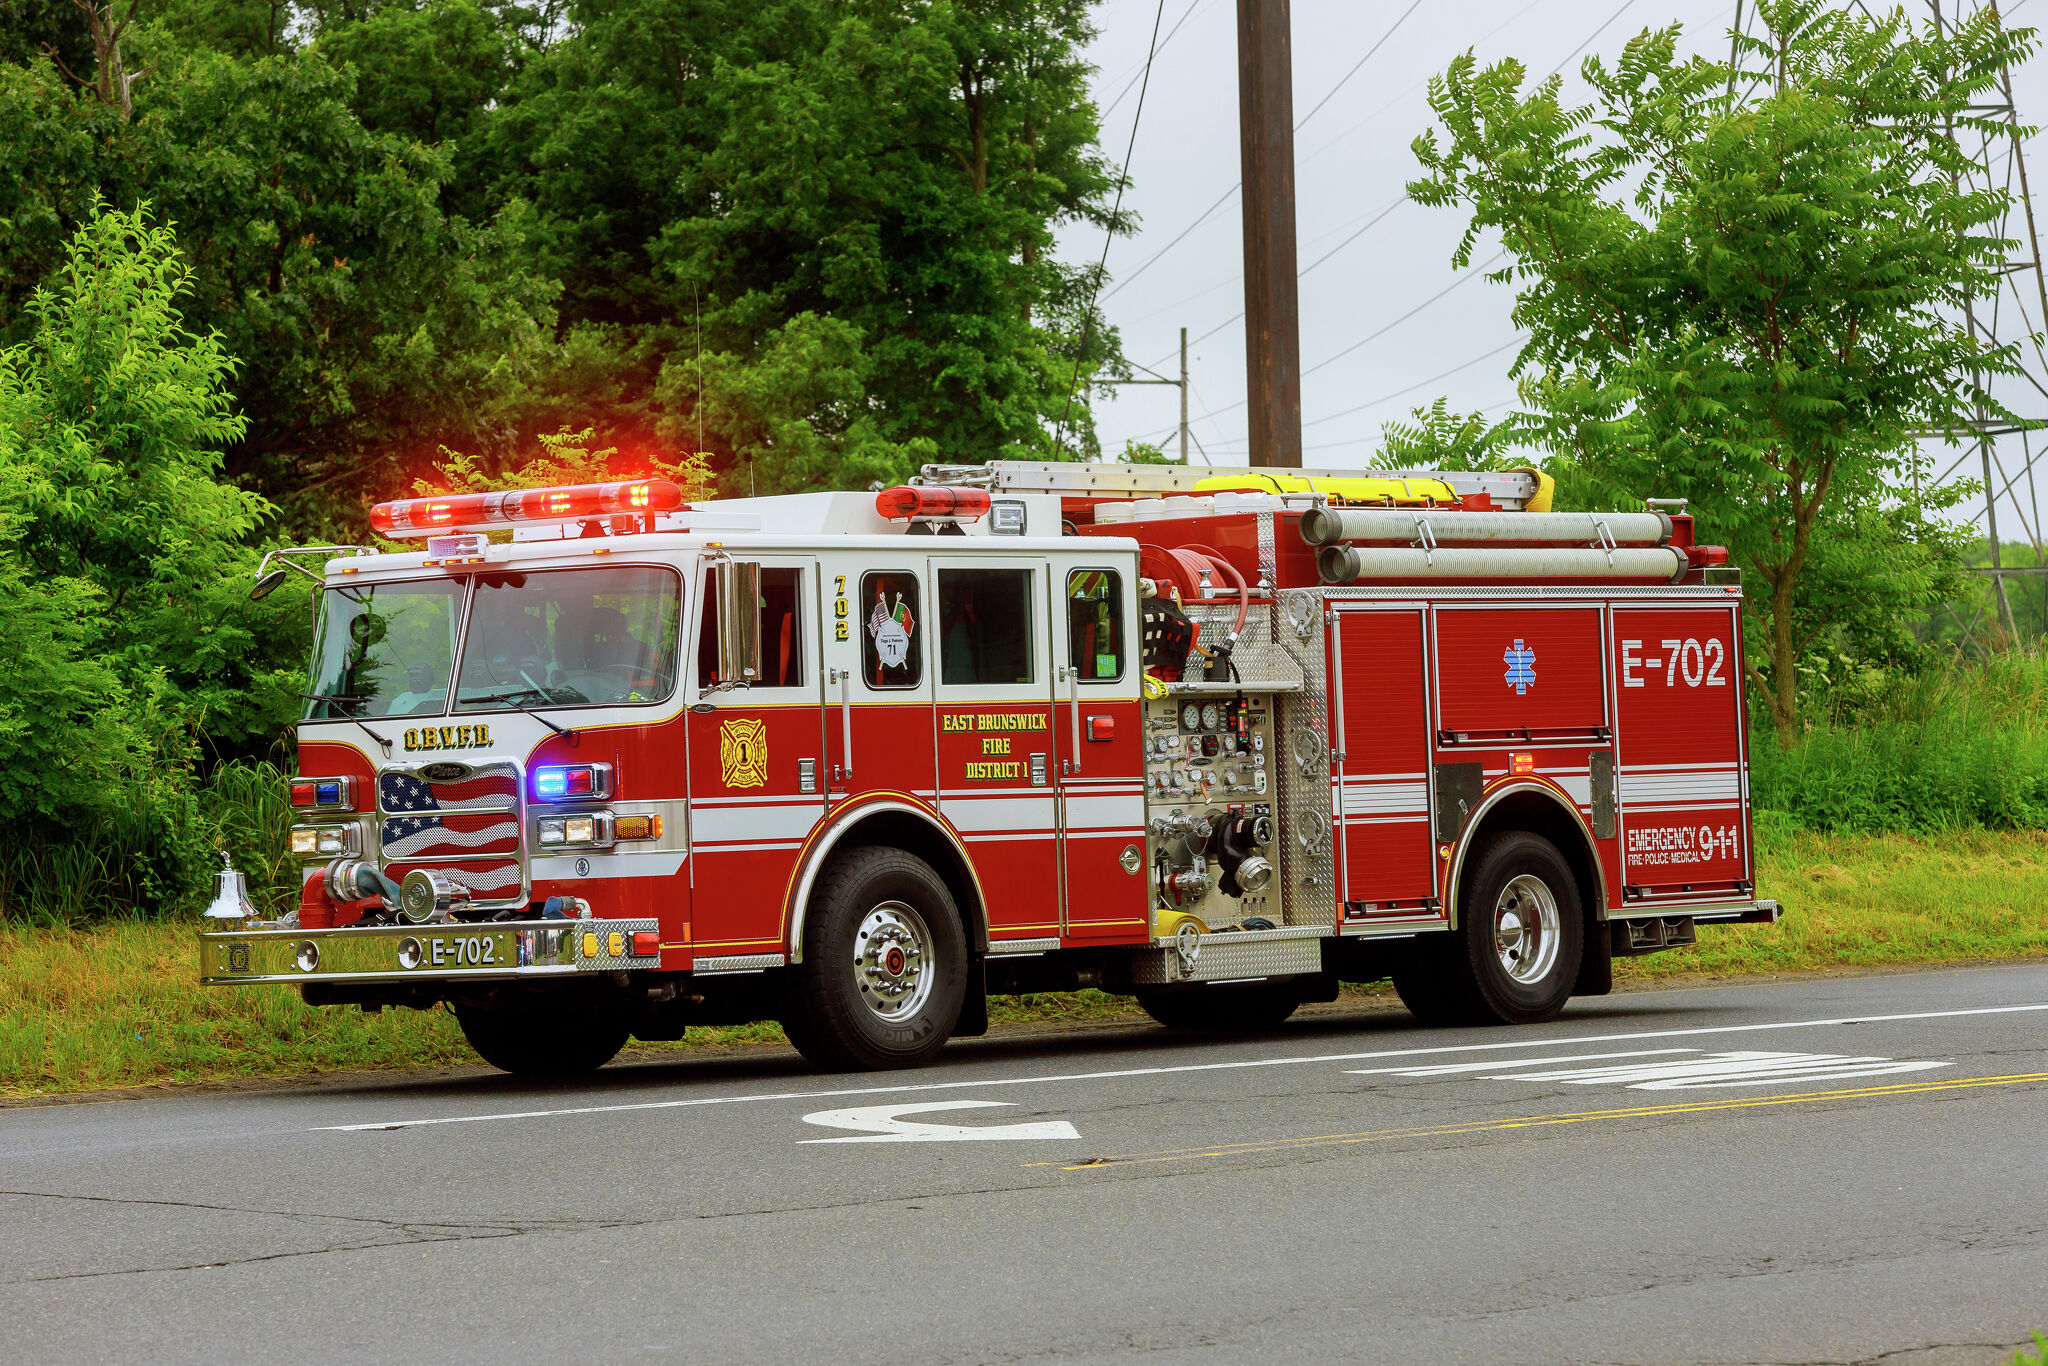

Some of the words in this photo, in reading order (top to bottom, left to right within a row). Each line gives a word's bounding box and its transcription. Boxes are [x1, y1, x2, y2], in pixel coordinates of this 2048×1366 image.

[887, 644, 897, 655] 71
[1622, 638, 1726, 687] E-702
[942, 714, 975, 733] EAST
[976, 713, 1047, 732] BRUNSWICK
[740, 743, 748, 763] 1
[981, 738, 1011, 757] FIRE
[965, 762, 1020, 781] DISTRICT
[1022, 761, 1029, 780] 1
[1628, 826, 1696, 852] EMERGENCY
[431, 936, 495, 966] E-702
